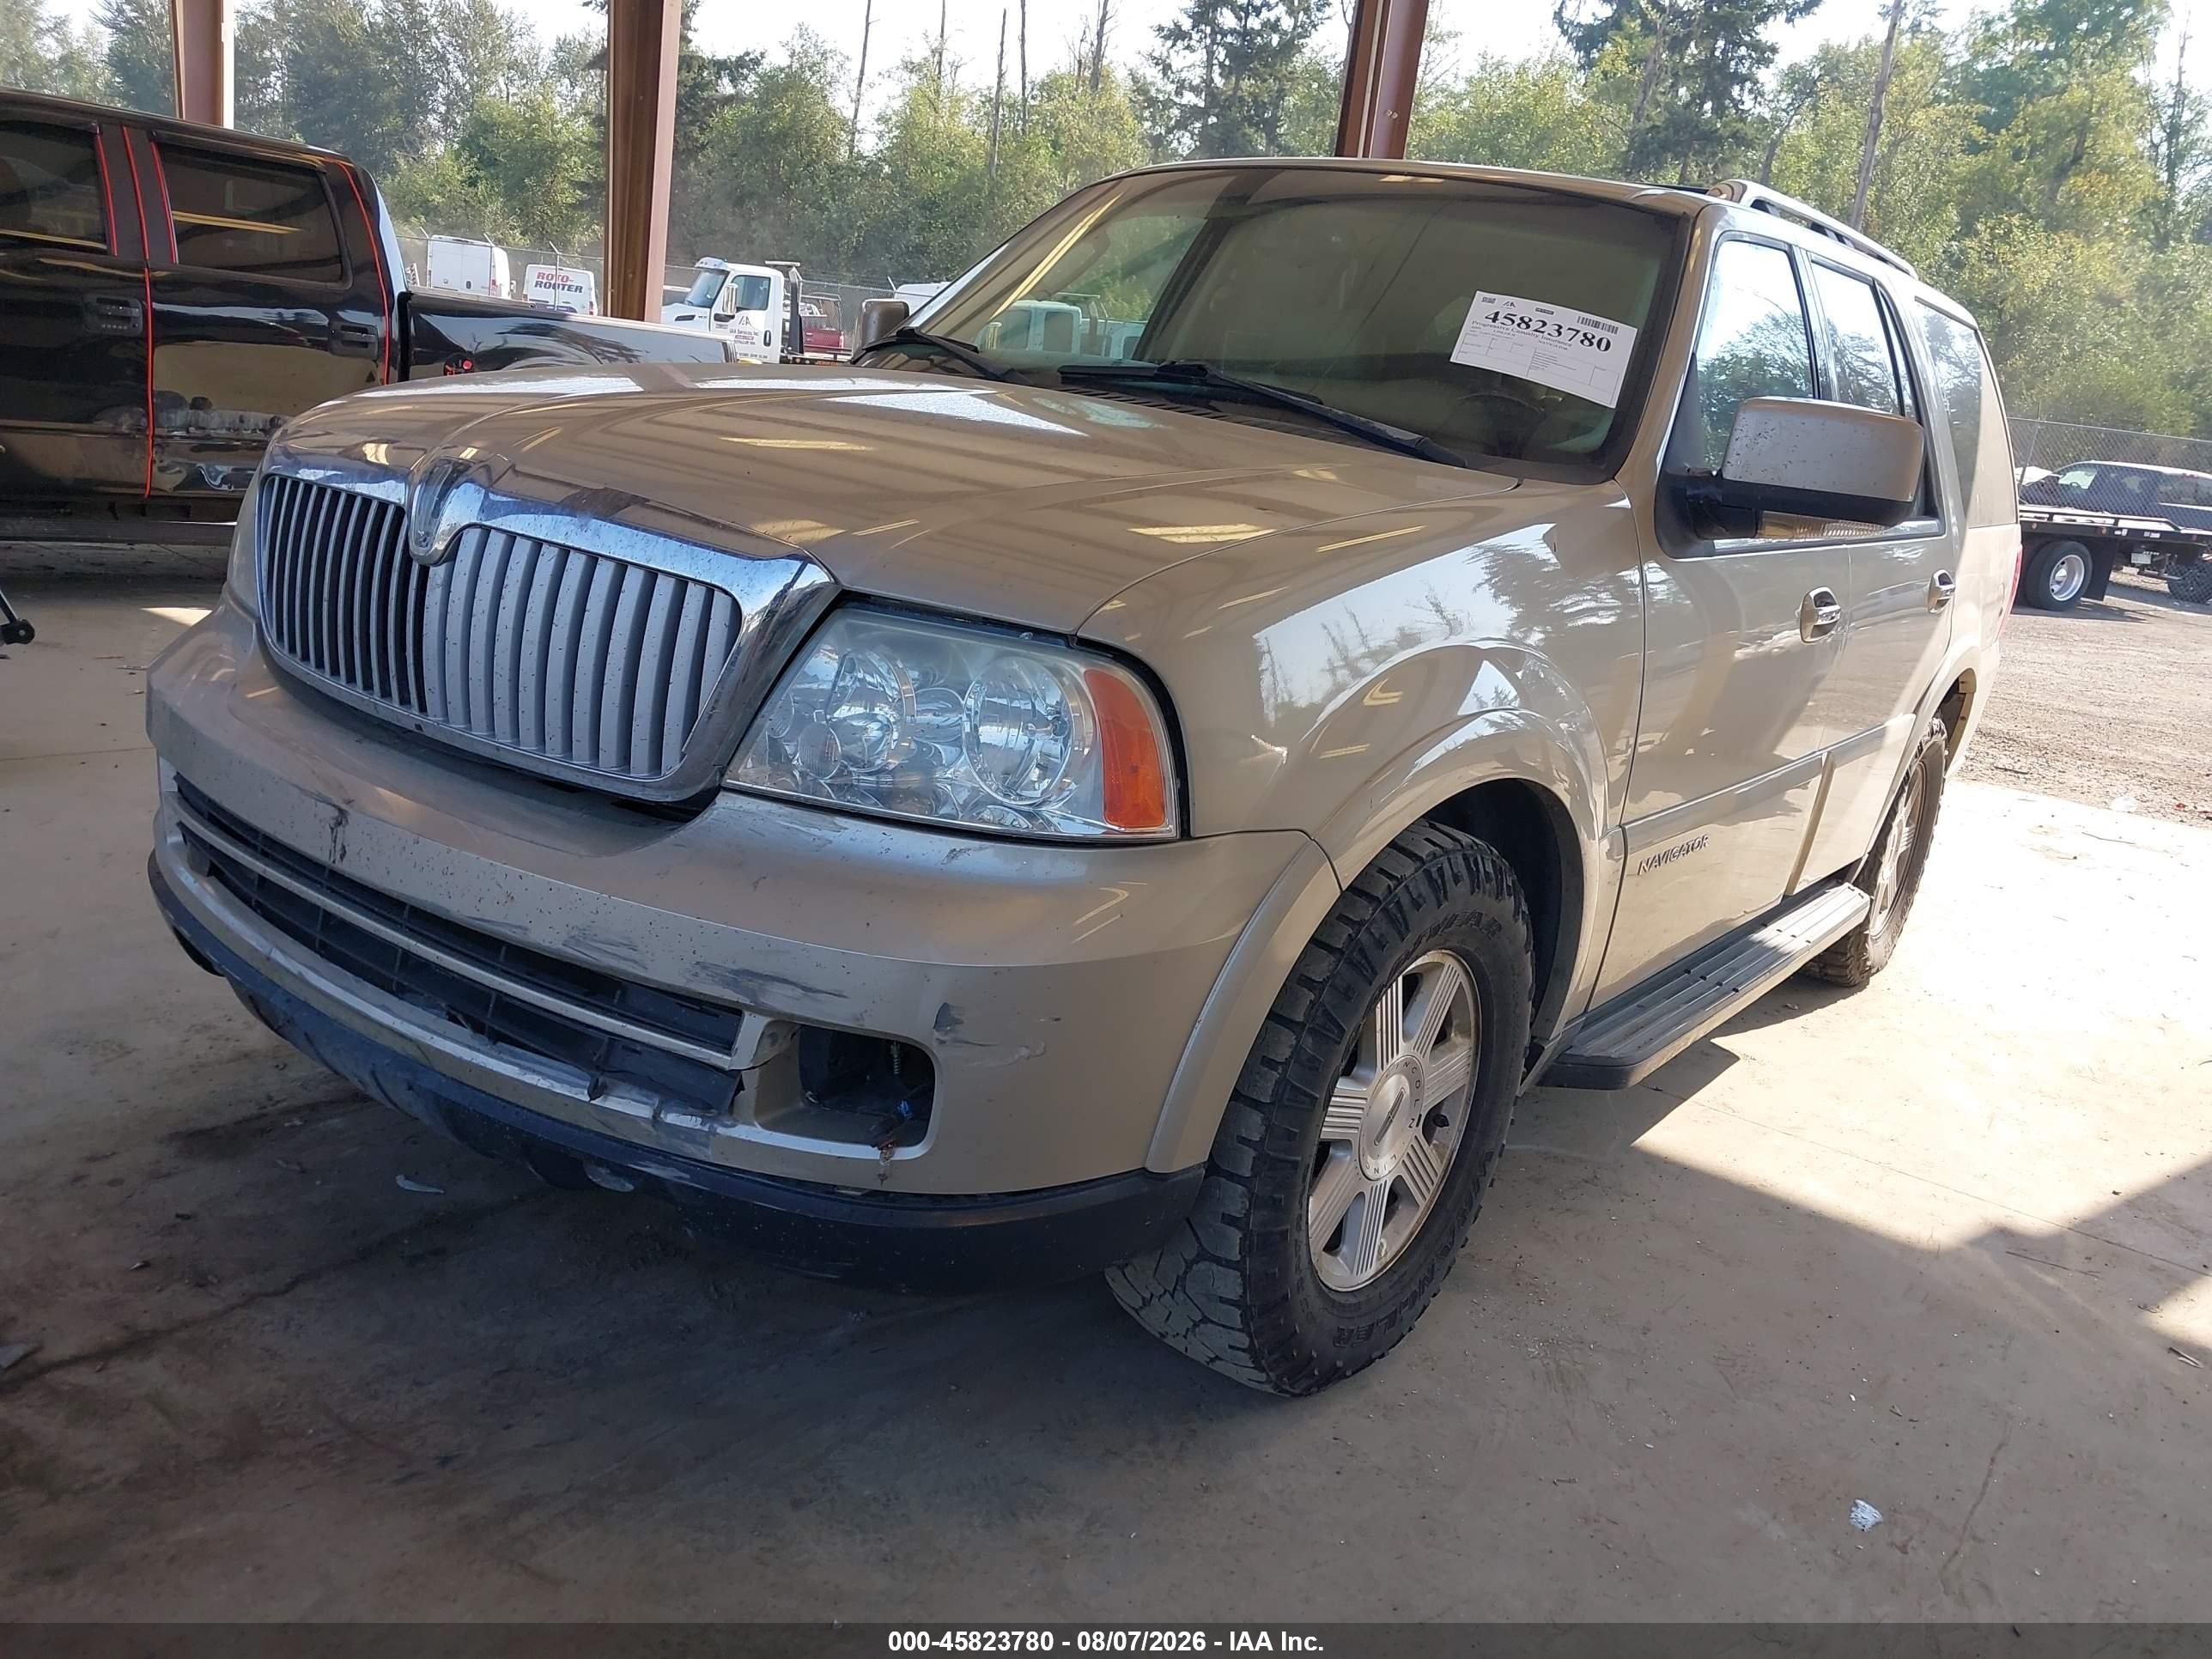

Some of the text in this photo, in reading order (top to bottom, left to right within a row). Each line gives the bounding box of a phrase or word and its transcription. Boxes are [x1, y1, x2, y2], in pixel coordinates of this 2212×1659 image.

[534, 281, 583, 293] ROOTER
[537, 272, 574, 283] ROTO-
[1472, 320, 1509, 331] Progressive
[1511, 326, 1539, 337] Casualty
[1541, 335, 1572, 347] Insurance
[1485, 310, 1612, 352] 45823780
[1638, 835, 1708, 875] NAVIGATOR
